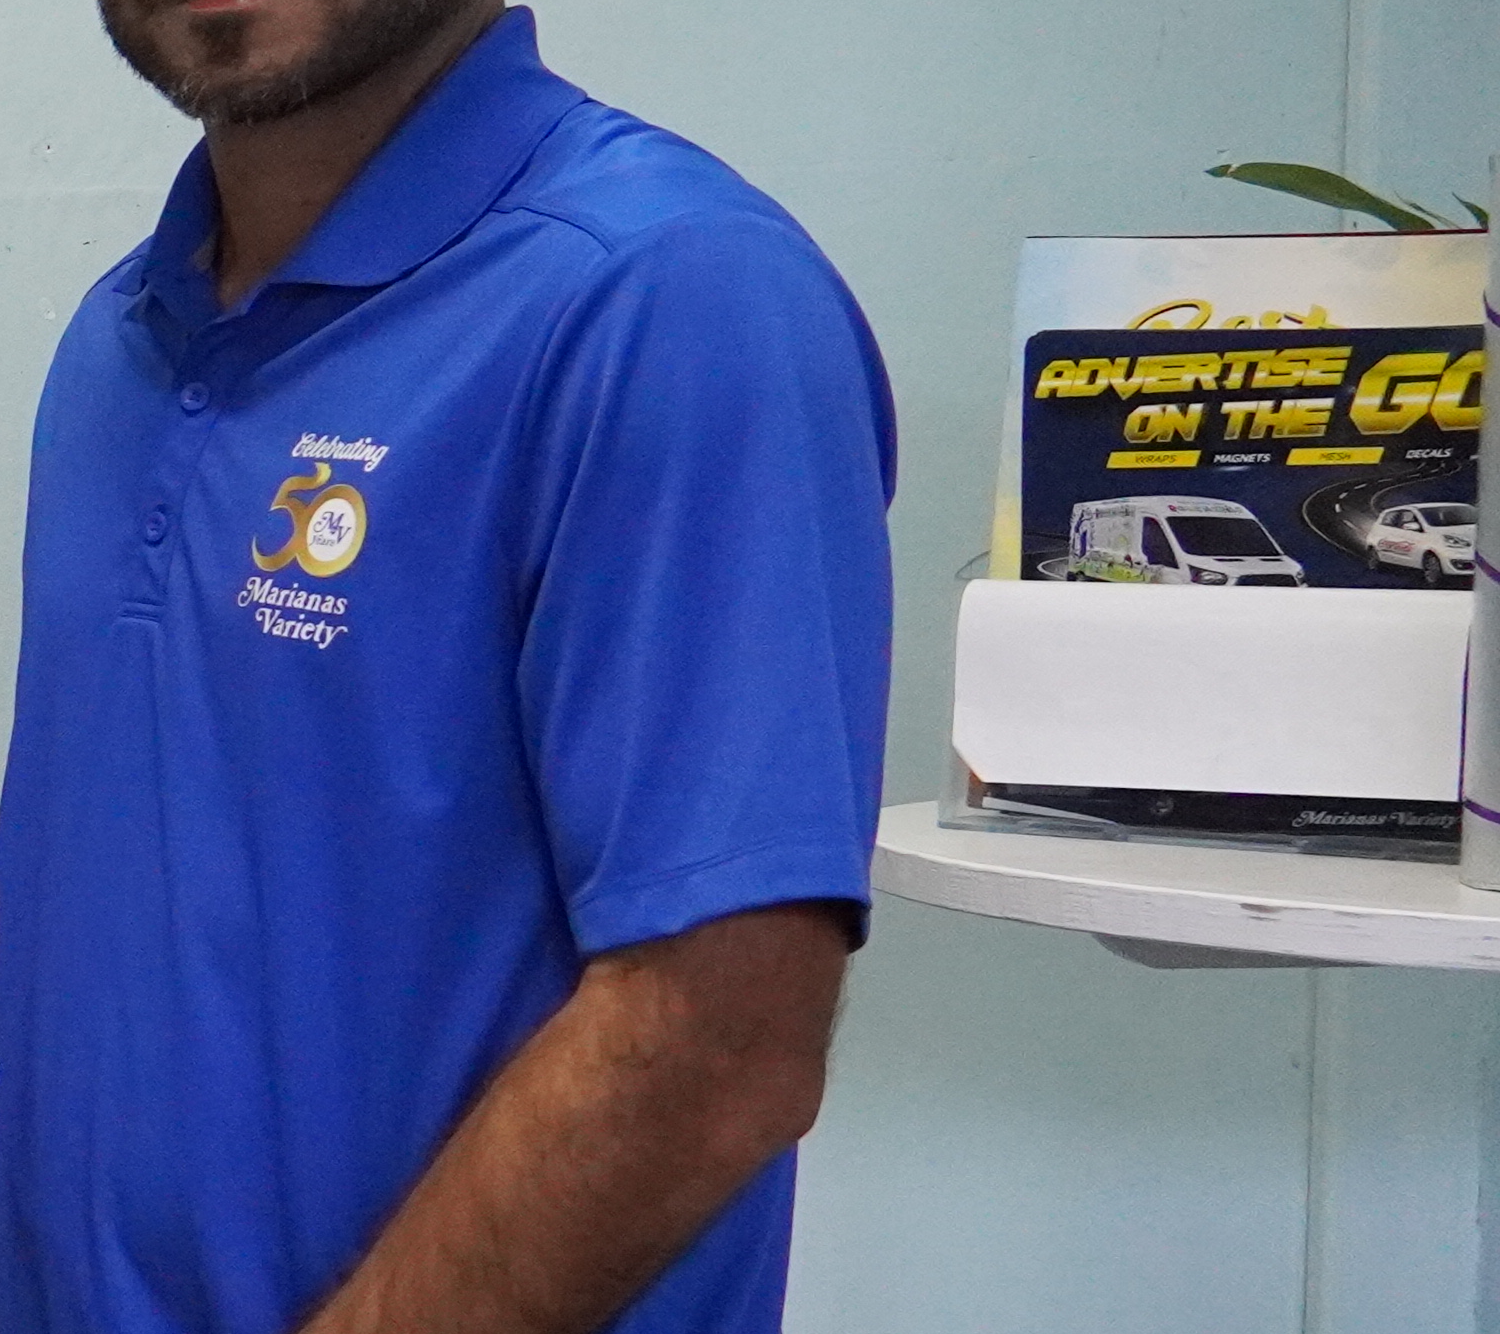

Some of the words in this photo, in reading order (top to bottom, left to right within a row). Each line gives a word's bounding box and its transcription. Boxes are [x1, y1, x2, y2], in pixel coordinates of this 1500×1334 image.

[1034, 345, 1353, 400] ADVERTISE
[1122, 402, 1204, 444] ON
[1220, 397, 1336, 441] THE
[291, 432, 390, 472] Celebrating
[1134, 453, 1177, 464] WRAPS
[1212, 452, 1272, 464] MAGNETS
[1405, 447, 1455, 459] DECALS
[252, 462, 367, 578] 50
[237, 576, 348, 616] Marianas
[255, 607, 349, 650] Variety
[1291, 810, 1386, 828] Marianas
[1389, 811, 1458, 829] Variety
